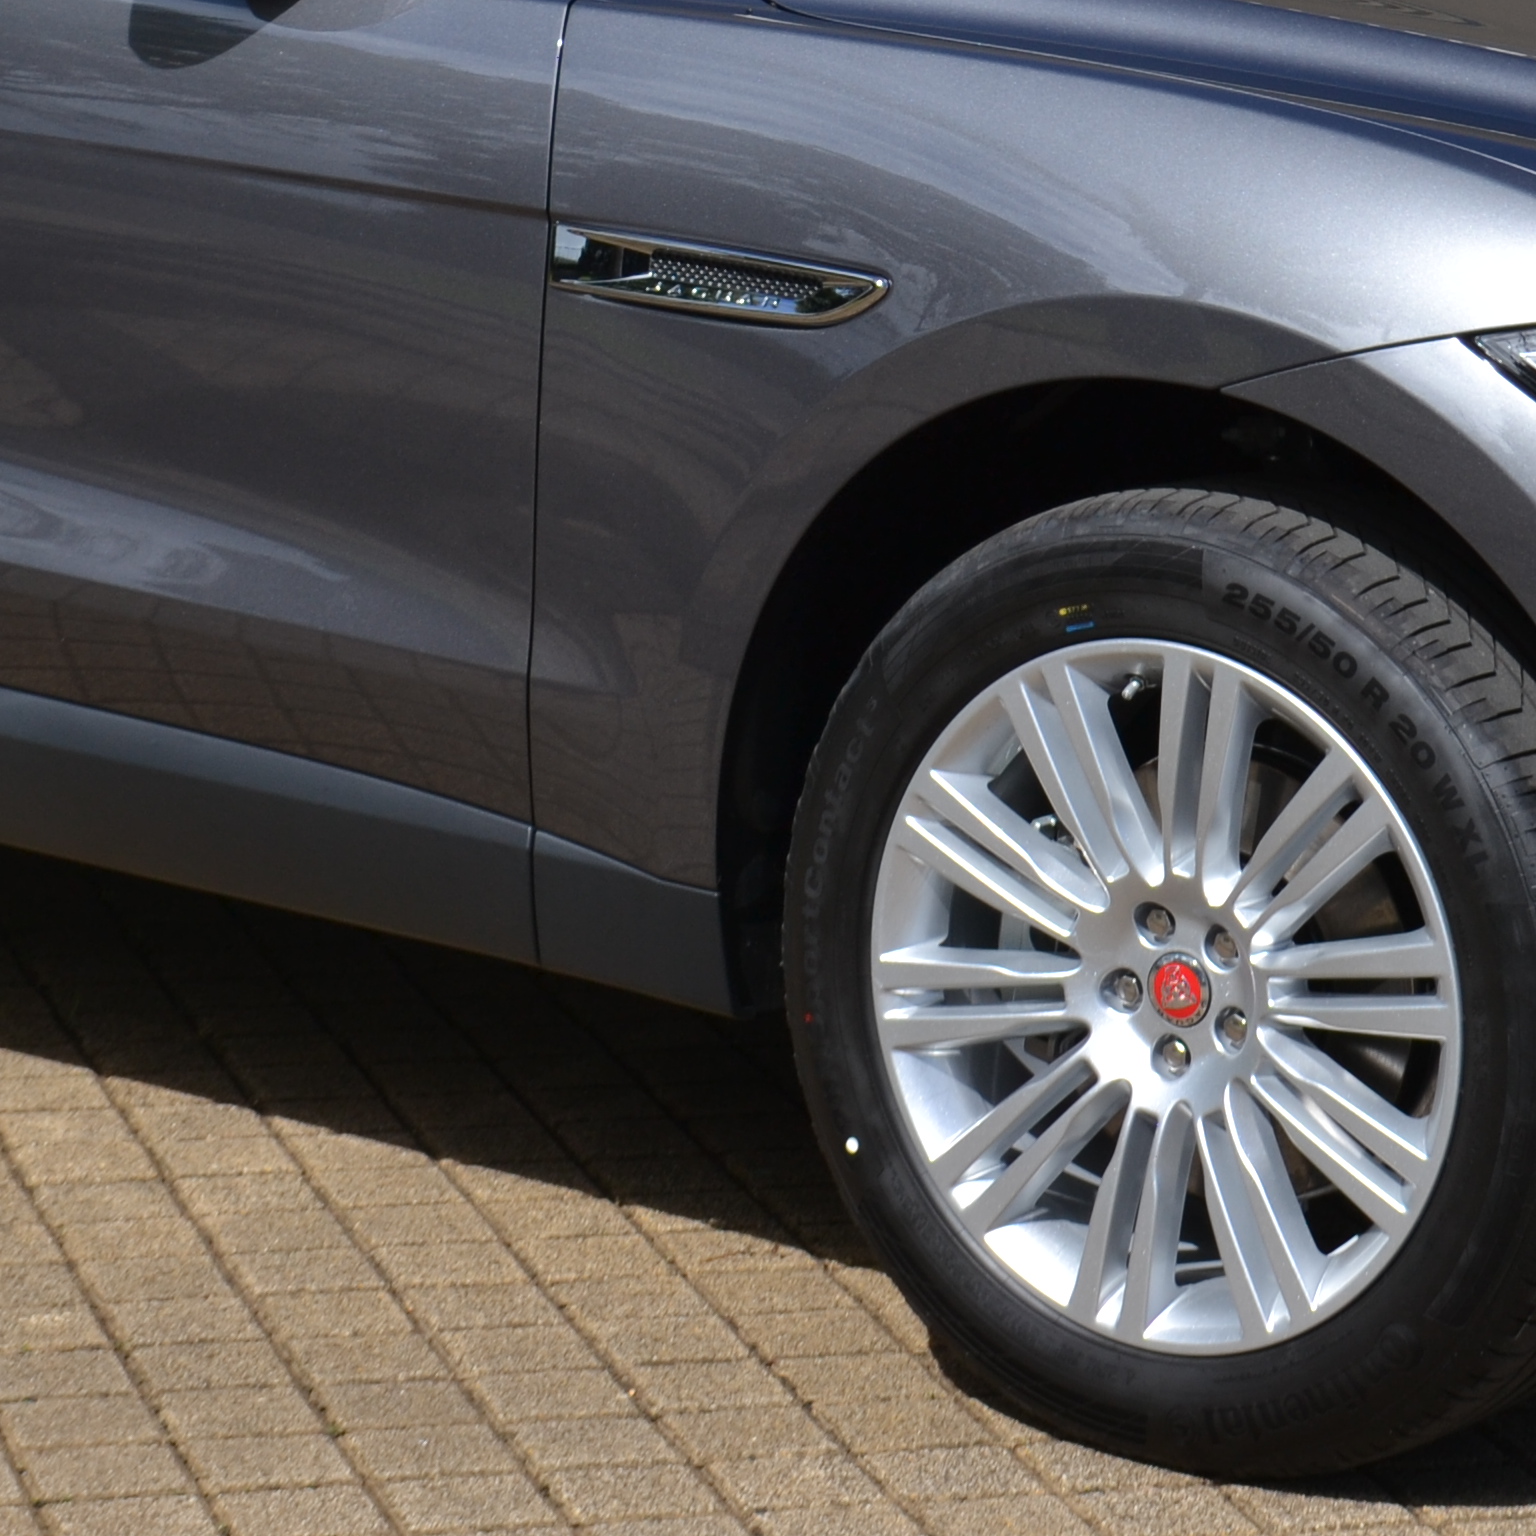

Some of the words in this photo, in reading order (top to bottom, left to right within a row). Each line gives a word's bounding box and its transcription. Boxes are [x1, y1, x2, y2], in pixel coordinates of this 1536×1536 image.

[645, 281, 780, 309] JAGUAR
[1221, 582, 1358, 679] 255/50
[1361, 677, 1391, 711] R
[1388, 713, 1436, 770] 20
[1433, 772, 1465, 811] W
